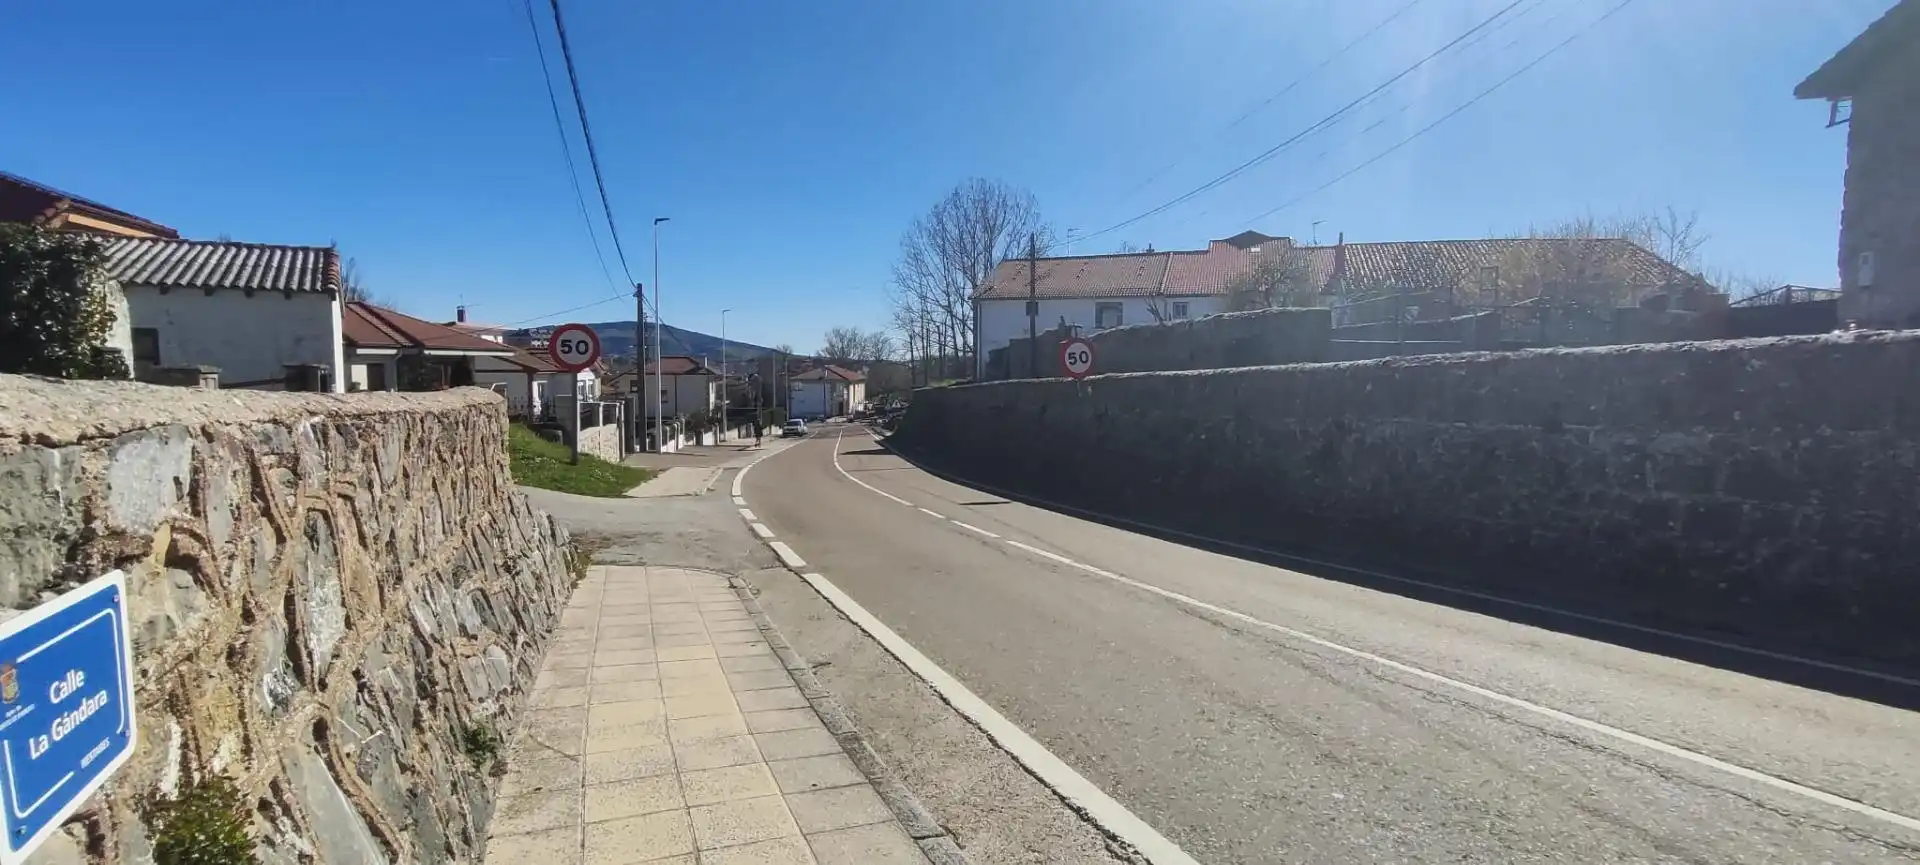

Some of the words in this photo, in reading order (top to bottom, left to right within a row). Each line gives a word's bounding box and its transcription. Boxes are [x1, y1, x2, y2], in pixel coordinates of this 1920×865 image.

[560, 339, 589, 355] 50
[1068, 350, 1089, 365] 50
[50, 669, 85, 704] Calle
[29, 734, 49, 760] La
[51, 689, 107, 742] Gándara
